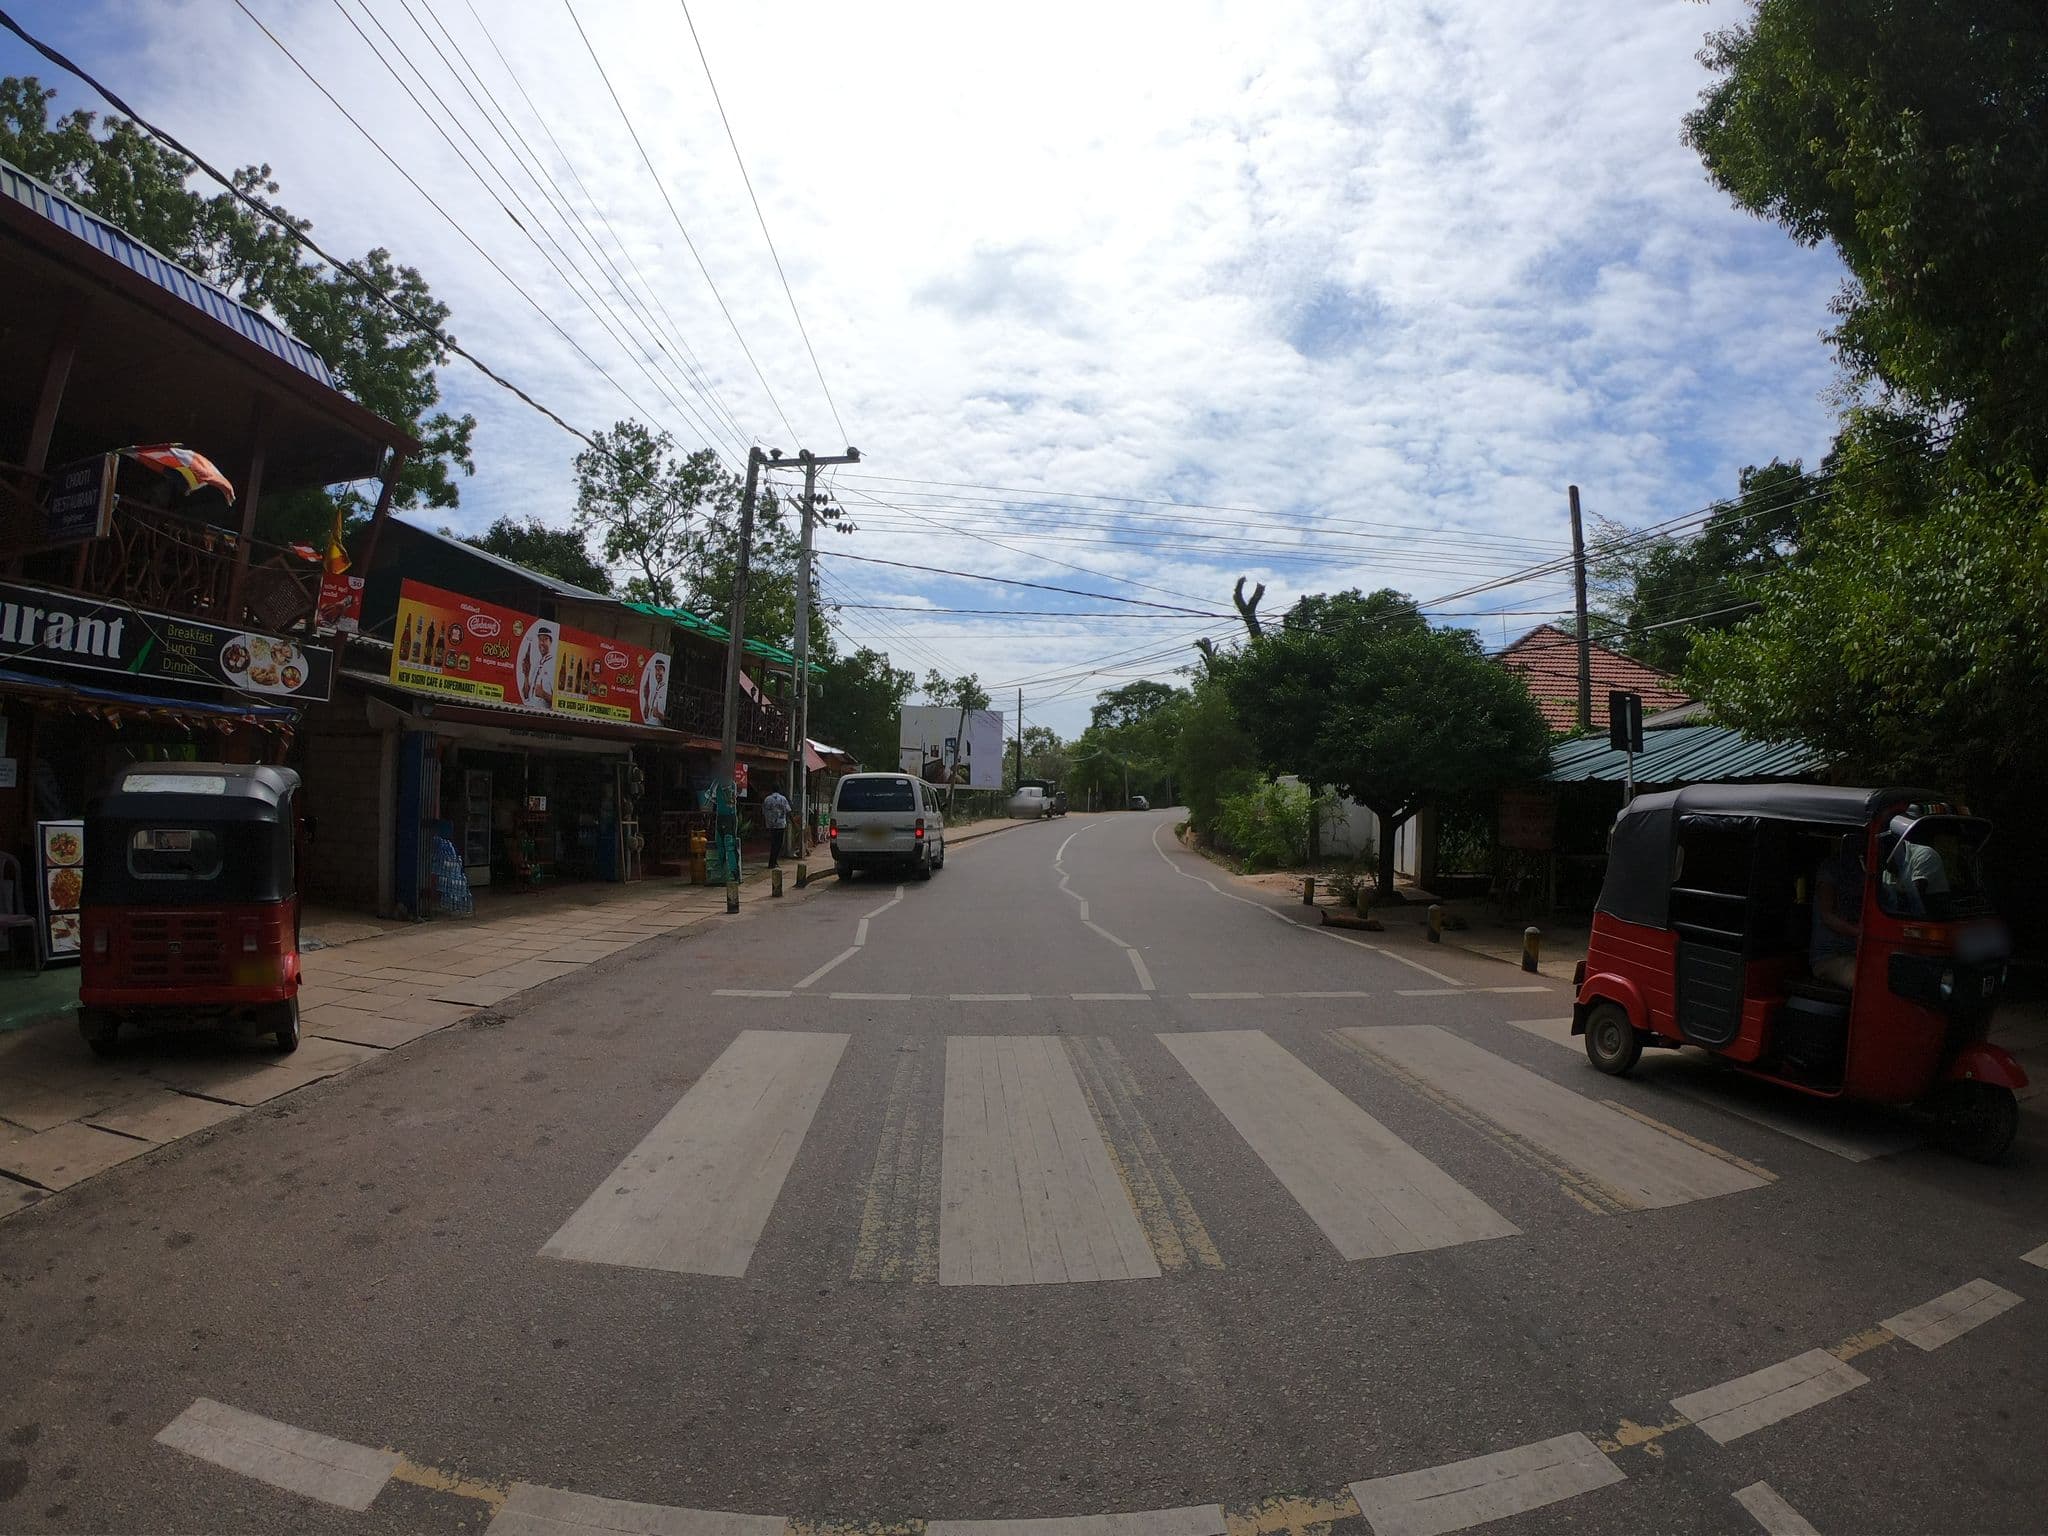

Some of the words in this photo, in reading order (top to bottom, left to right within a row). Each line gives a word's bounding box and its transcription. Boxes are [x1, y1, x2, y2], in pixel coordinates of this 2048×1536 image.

[167, 623, 215, 644] Breakfast
[167, 640, 198, 656] Lunch
[162, 657, 198, 674] Dinner
[399, 671, 410, 683] NEW
[426, 676, 439, 688] CAFE
[443, 679, 475, 693] SUPERMARKET
